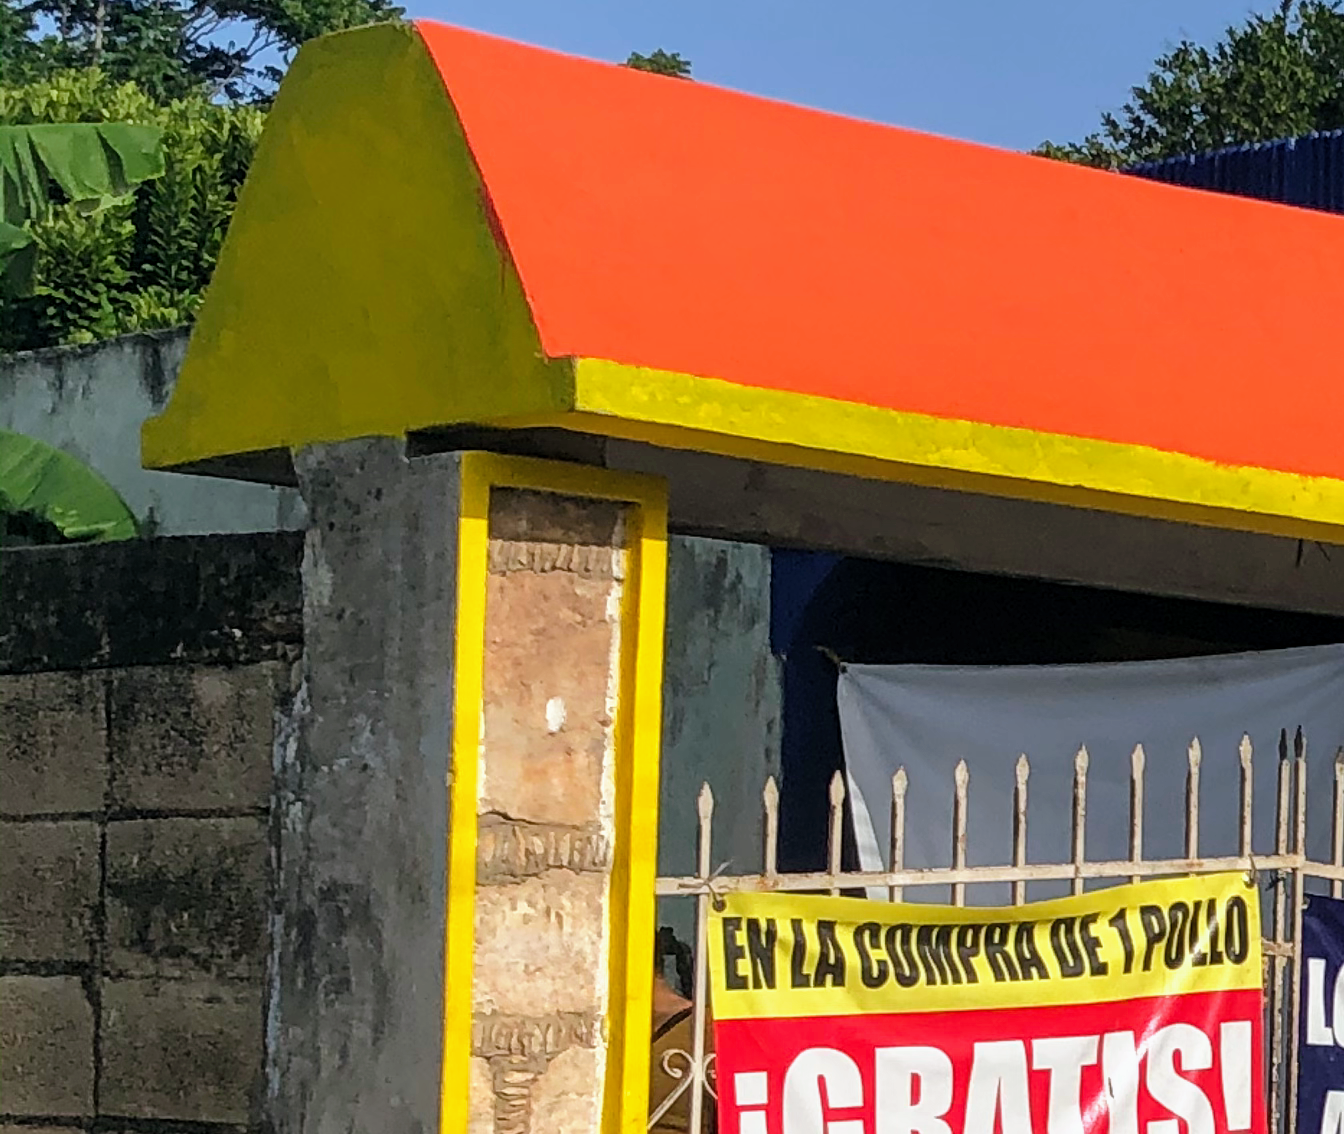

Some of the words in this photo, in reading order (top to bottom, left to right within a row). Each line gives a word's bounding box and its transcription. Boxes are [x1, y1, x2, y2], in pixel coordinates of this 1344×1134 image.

[721, 916, 776, 991] EN
[790, 918, 845, 990] LA
[859, 909, 1050, 989] COMPRA
[1055, 906, 1103, 979] DE
[1106, 901, 1135, 972] 1
[1142, 895, 1249, 969] POLLO
